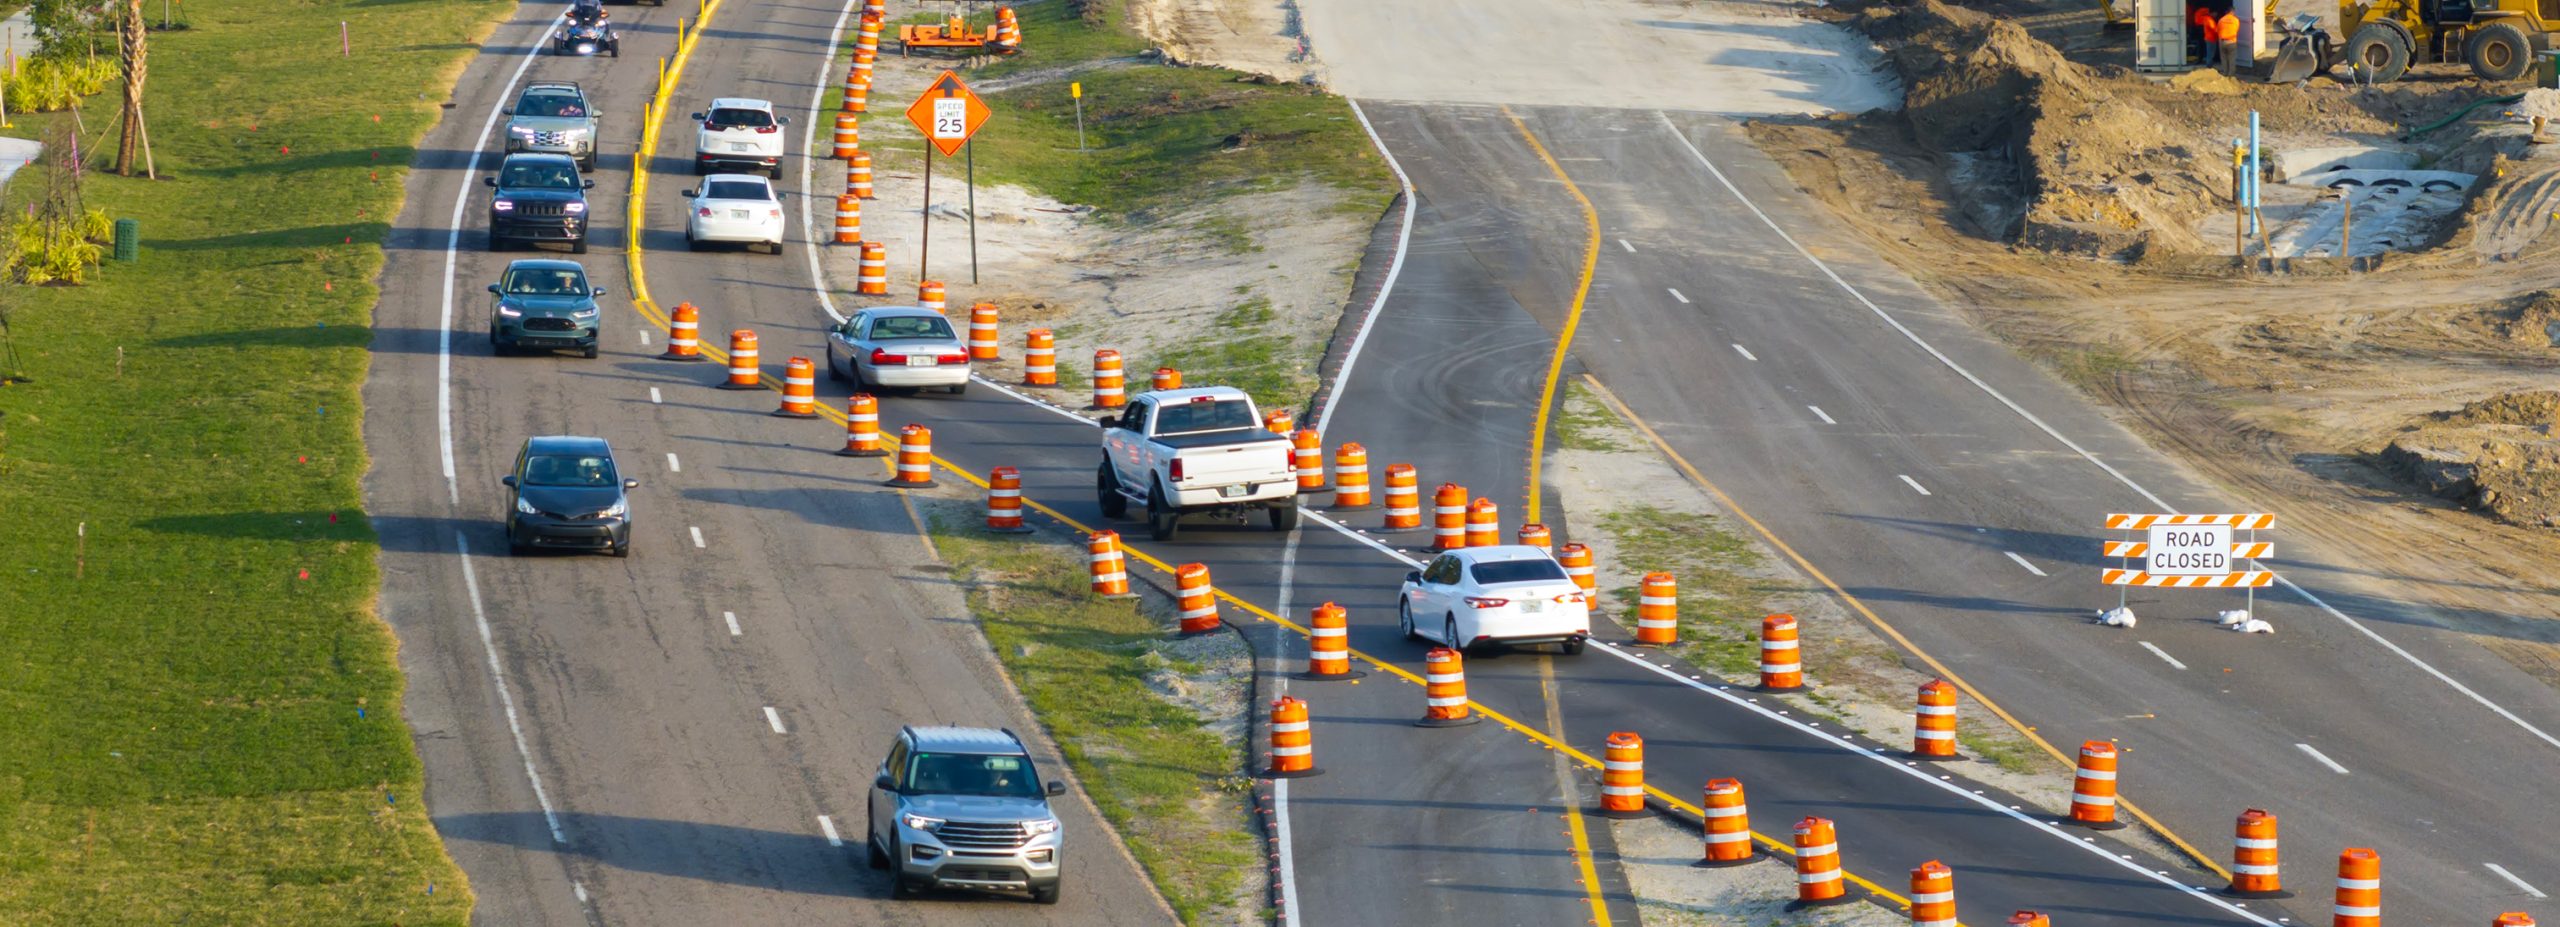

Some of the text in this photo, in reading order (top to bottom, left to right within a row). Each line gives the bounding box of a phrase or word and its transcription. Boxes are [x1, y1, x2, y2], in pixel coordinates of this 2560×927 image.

[938, 118, 963, 133] 25
[2166, 532, 2215, 547] ROAD
[2155, 553, 2224, 568] CLOSED
